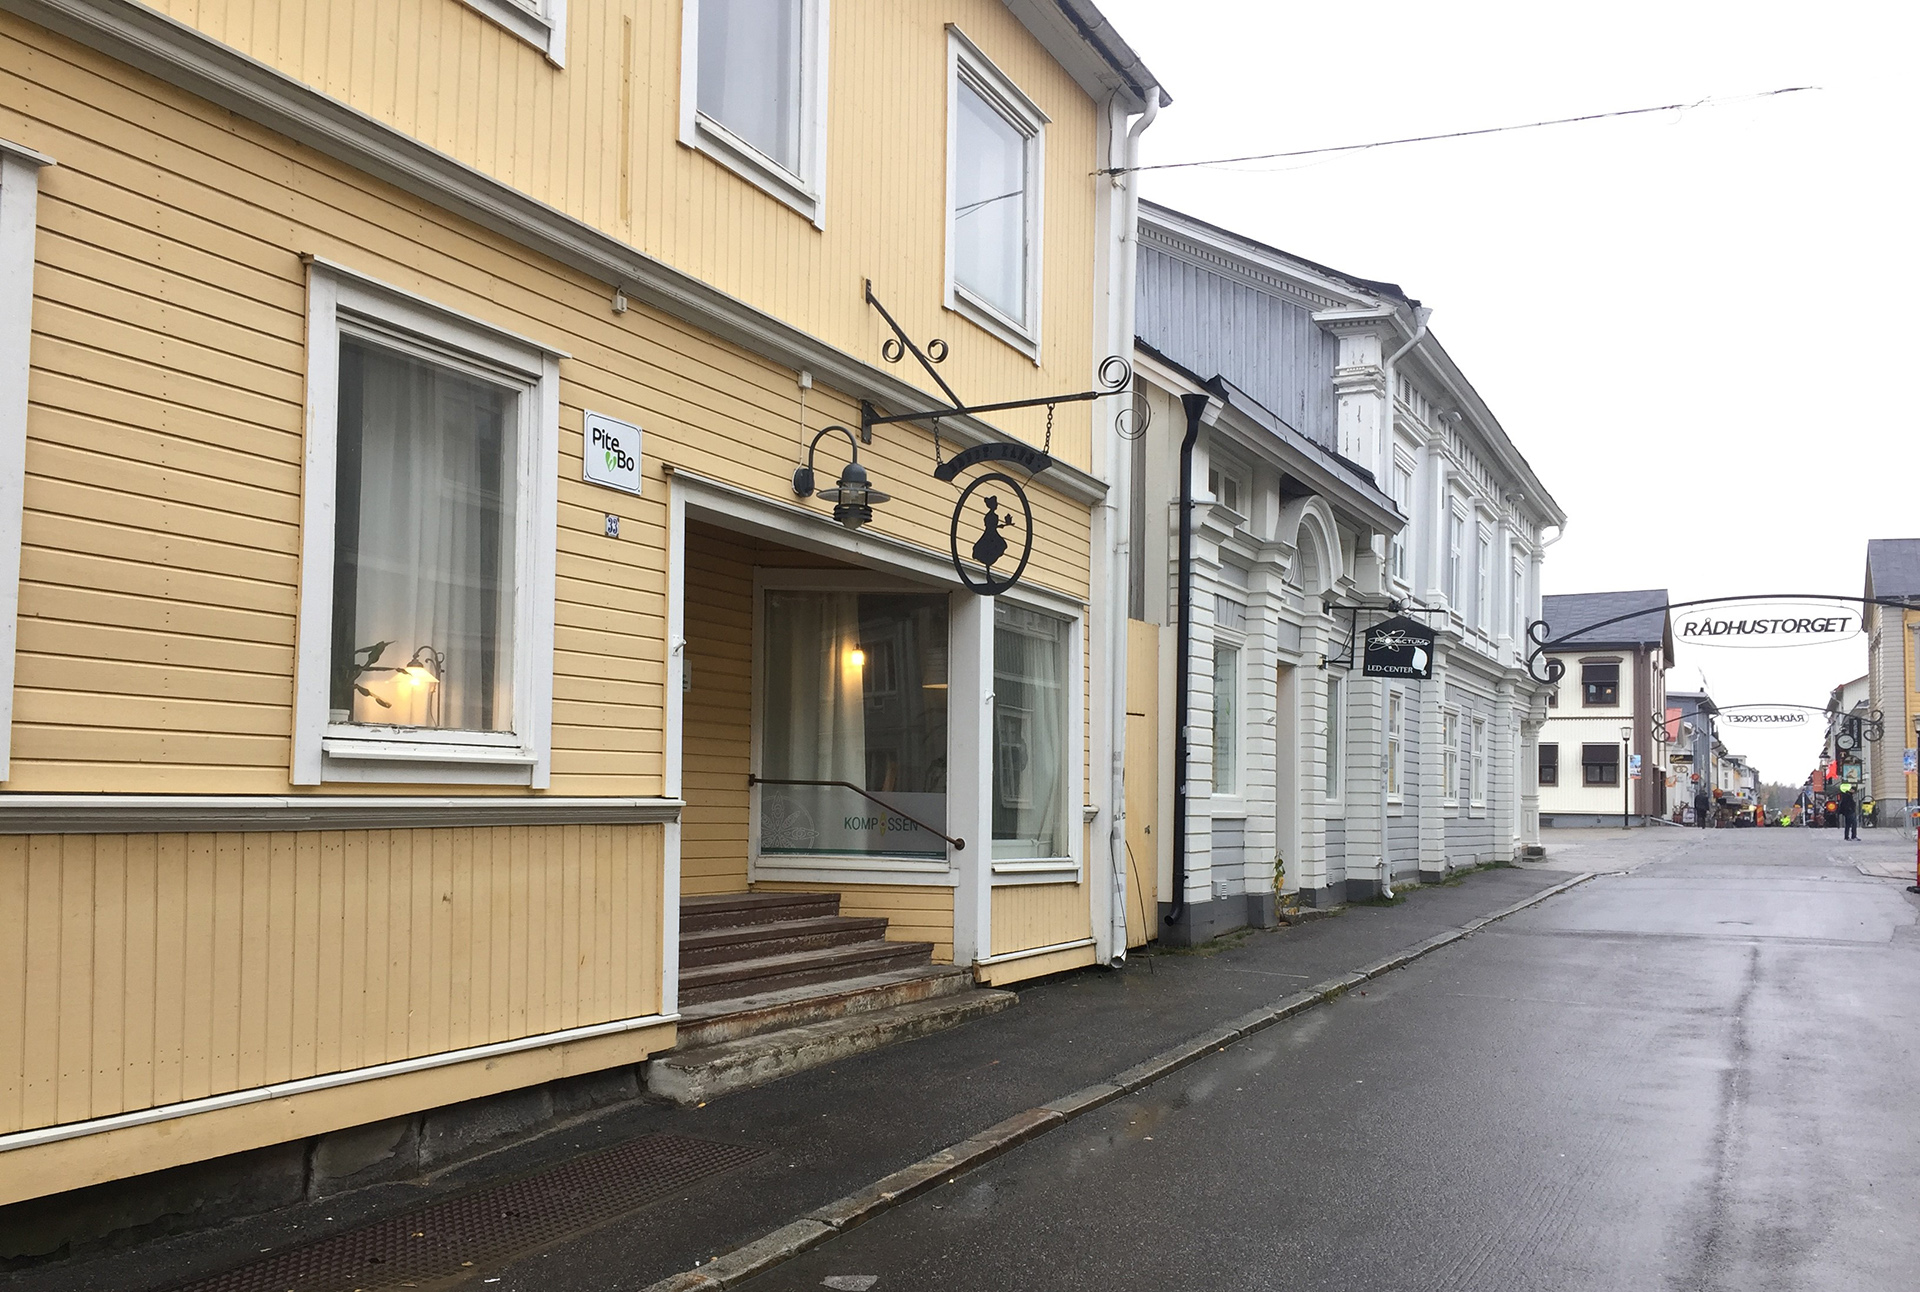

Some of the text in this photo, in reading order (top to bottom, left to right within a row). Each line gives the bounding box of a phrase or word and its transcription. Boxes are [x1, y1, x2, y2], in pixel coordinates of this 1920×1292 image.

[592, 427, 620, 453] Pite
[617, 449, 635, 472] Bo
[607, 517, 618, 535] 33
[1683, 616, 1852, 637] RÅDHUSTORGET
[1367, 665, 1413, 674] LED-CENTER
